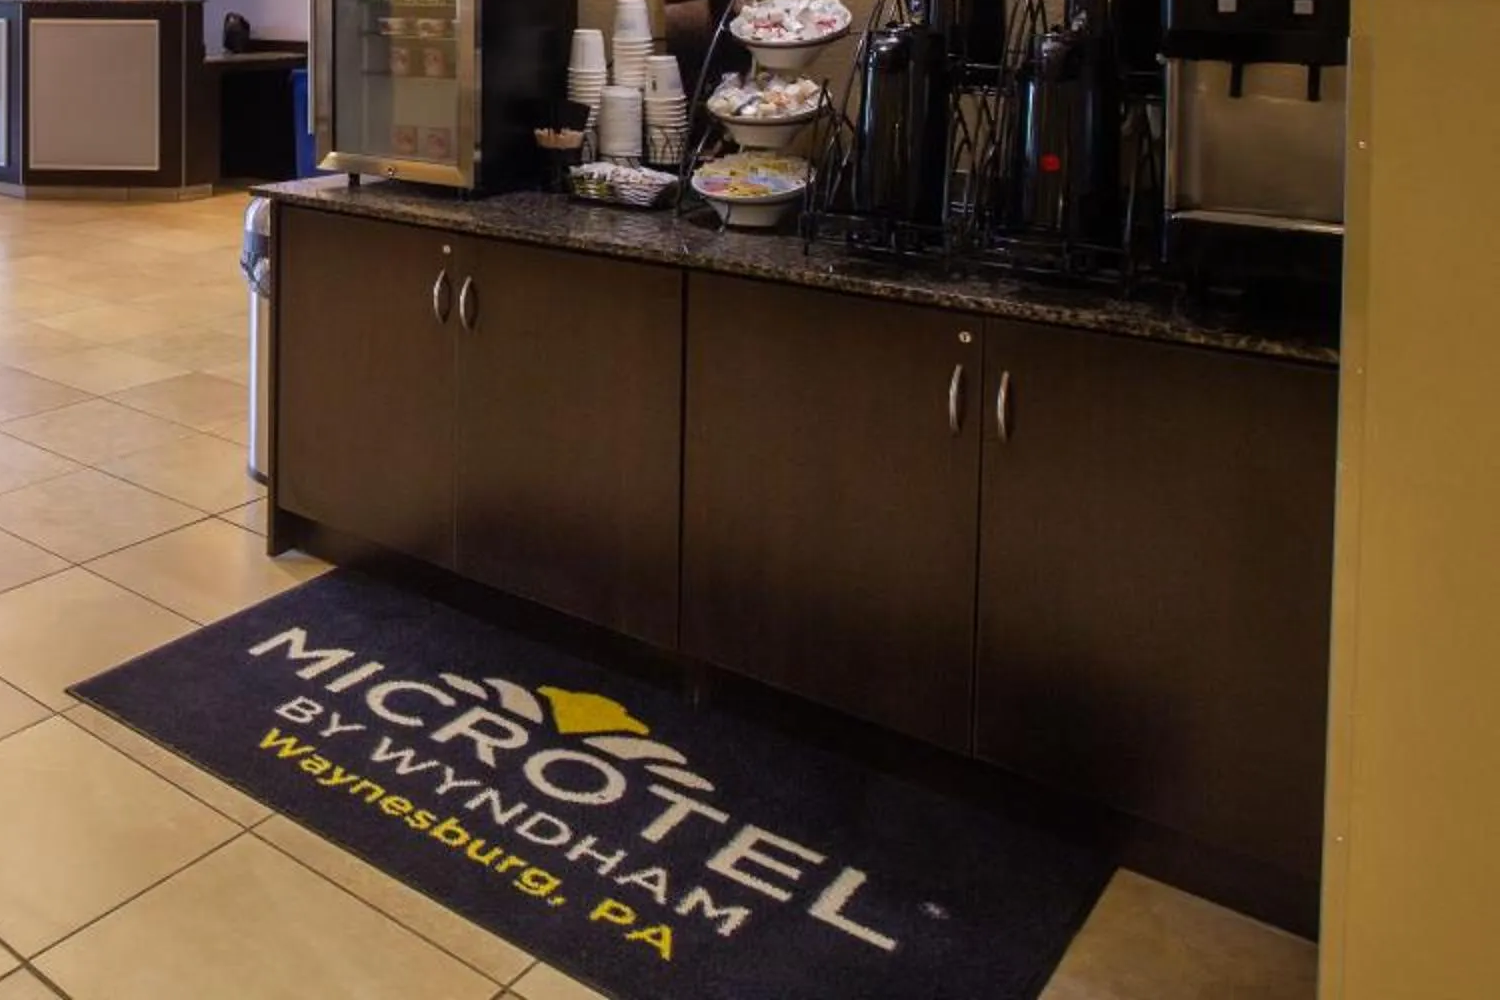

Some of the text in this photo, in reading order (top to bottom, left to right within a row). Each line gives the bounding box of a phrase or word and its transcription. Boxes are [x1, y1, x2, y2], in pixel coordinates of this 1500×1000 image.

[247, 626, 898, 952] MICROTEL
[258, 726, 675, 962] Waynesburg, PA
[274, 695, 753, 938] BY WYNDHAM
